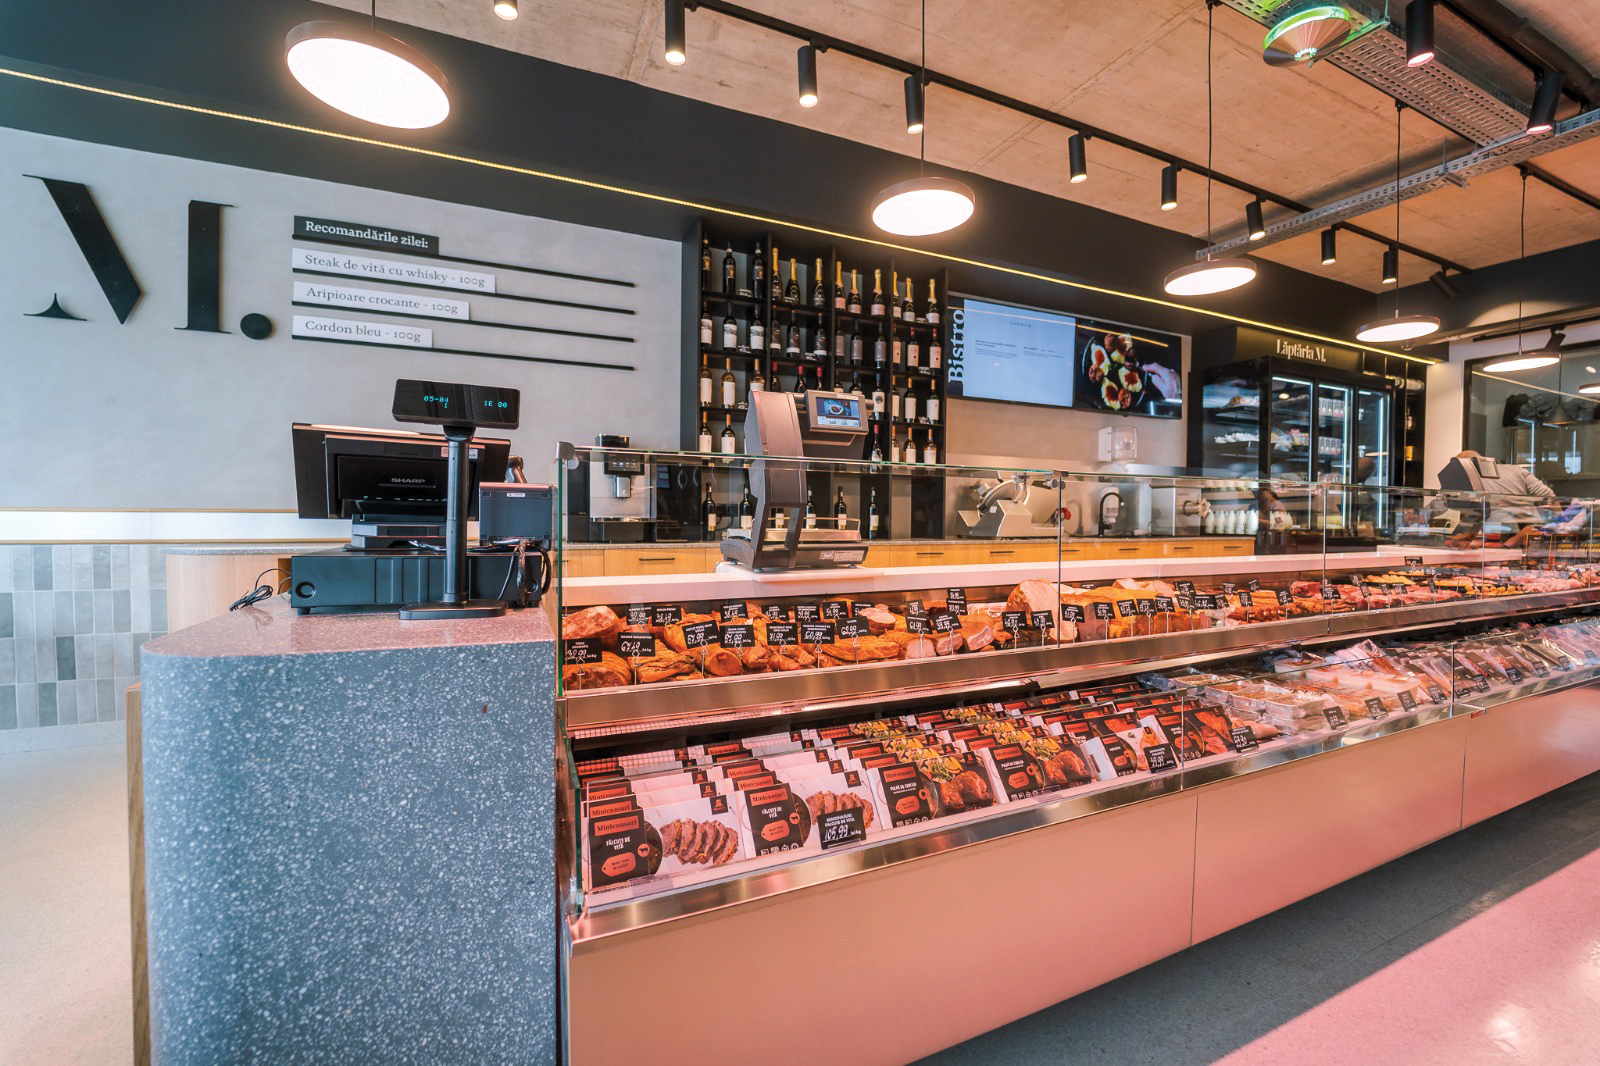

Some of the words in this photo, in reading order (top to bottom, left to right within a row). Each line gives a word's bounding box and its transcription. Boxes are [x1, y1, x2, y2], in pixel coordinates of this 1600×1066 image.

[305, 220, 399, 243] Recomandările
[401, 235, 429, 248] zilei:
[305, 254, 340, 268] Steak
[343, 259, 359, 271] de
[362, 262, 385, 274] vită
[388, 267, 403, 276] cu
[406, 268, 448, 284] whisky
[459, 276, 485, 288] 100g
[306, 287, 366, 303] Aripioare
[368, 296, 421, 309] crocante
[432, 303, 459, 315] 100g
[305, 320, 352, 334] Cordon
[356, 323, 381, 337] bleu
[394, 331, 421, 343] 100g
[948, 309, 965, 383] Bistro
[1276, 339, 1314, 360] Lăptăria
